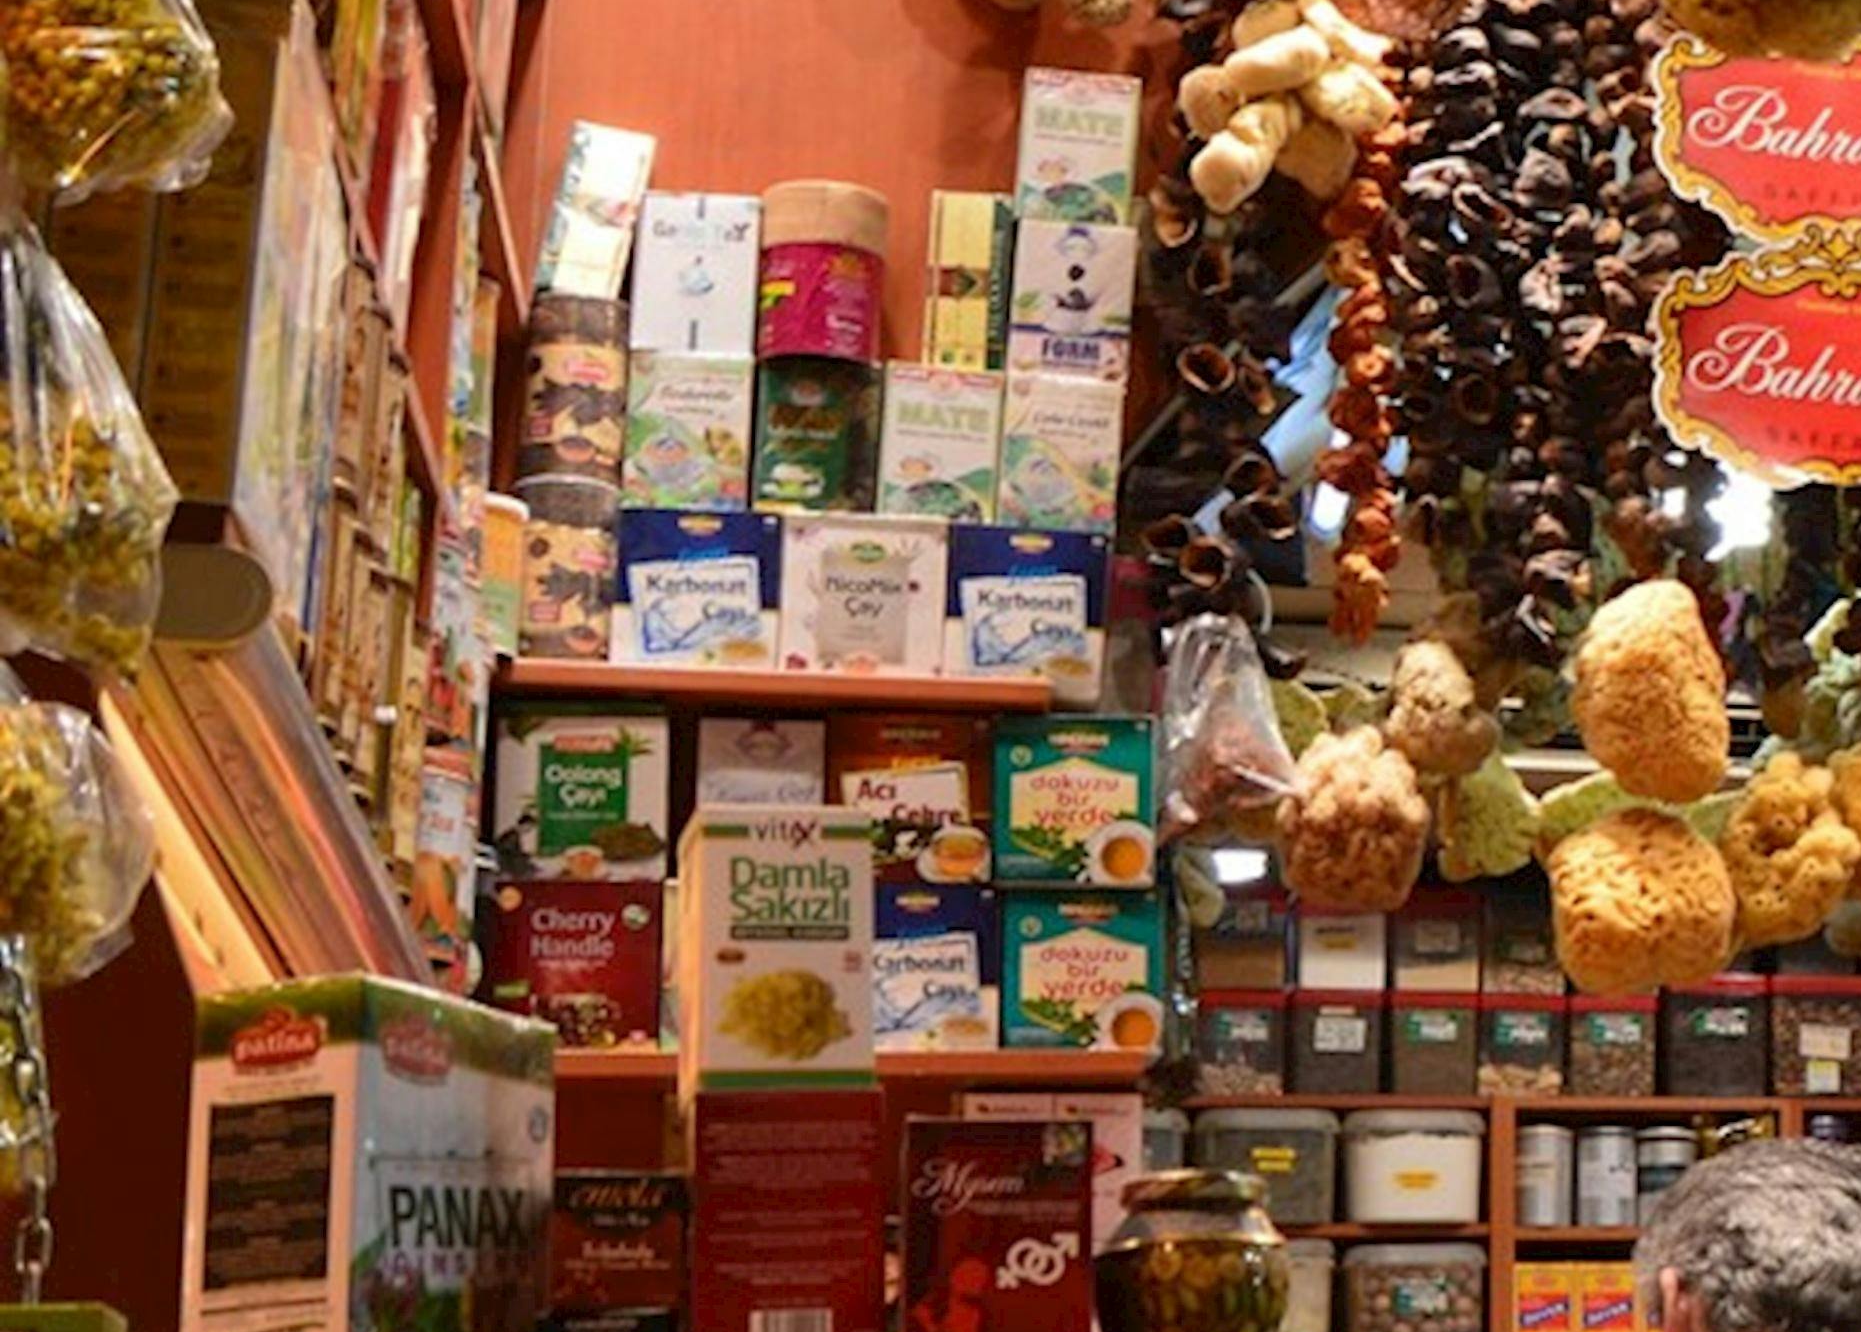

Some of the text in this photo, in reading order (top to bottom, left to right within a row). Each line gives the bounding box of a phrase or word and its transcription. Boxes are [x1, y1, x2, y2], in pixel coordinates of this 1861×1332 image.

[646, 573, 747, 597] Karbonat
[977, 589, 1076, 614] Karbonat
[544, 764, 622, 789] Oolong
[1029, 771, 1120, 792] dokuzu
[856, 779, 896, 800] Acı
[1056, 791, 1088, 807] bir
[1034, 807, 1114, 828] yerde
[729, 855, 850, 889] Damla
[729, 889, 850, 923] Sakızlı
[530, 908, 617, 938] Cherry
[529, 934, 616, 960] Handle
[1039, 945, 1131, 965] dokuzu
[1066, 963, 1100, 978] bir
[1040, 979, 1126, 999] yerde
[388, 1183, 525, 1250] PANAX
